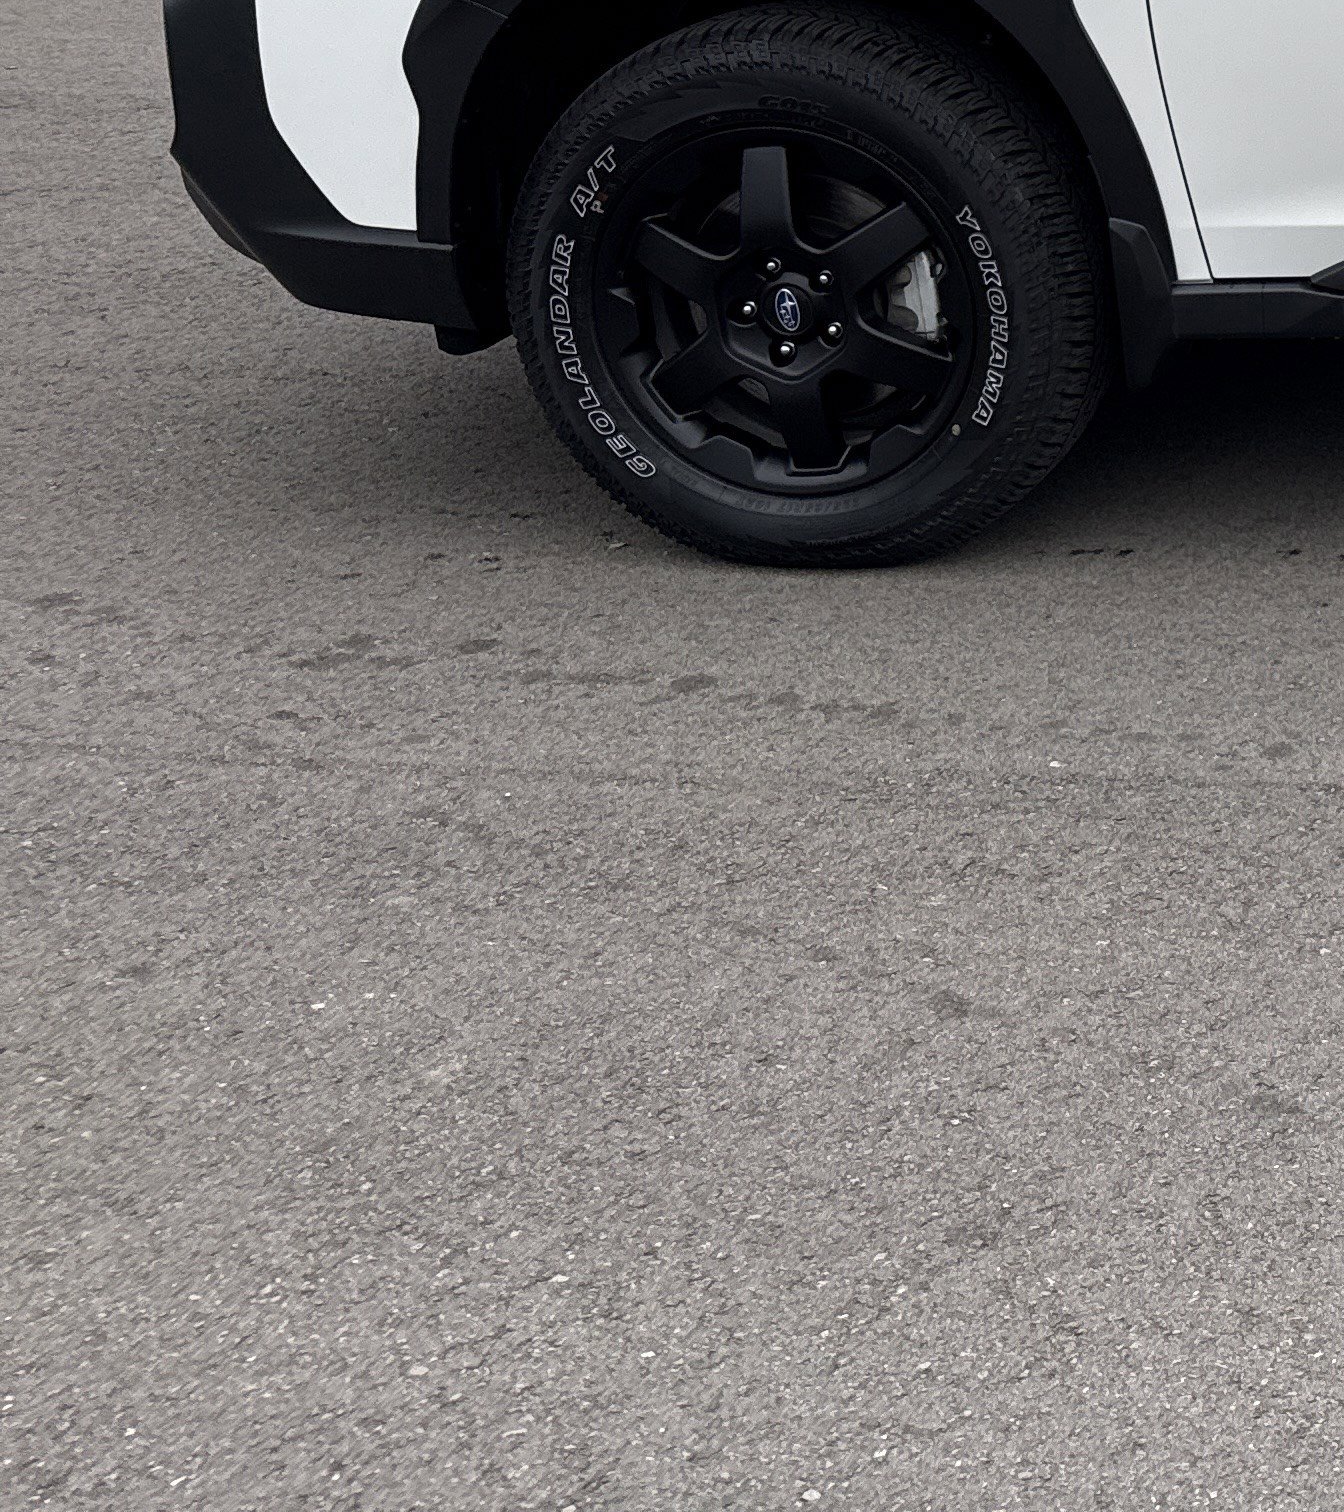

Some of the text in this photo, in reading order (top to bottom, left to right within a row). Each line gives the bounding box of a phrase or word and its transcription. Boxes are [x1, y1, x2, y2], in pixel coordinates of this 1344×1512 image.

[550, 145, 656, 478] GEOLANDAR A/T
[955, 205, 1009, 426] YOKOHAMA
